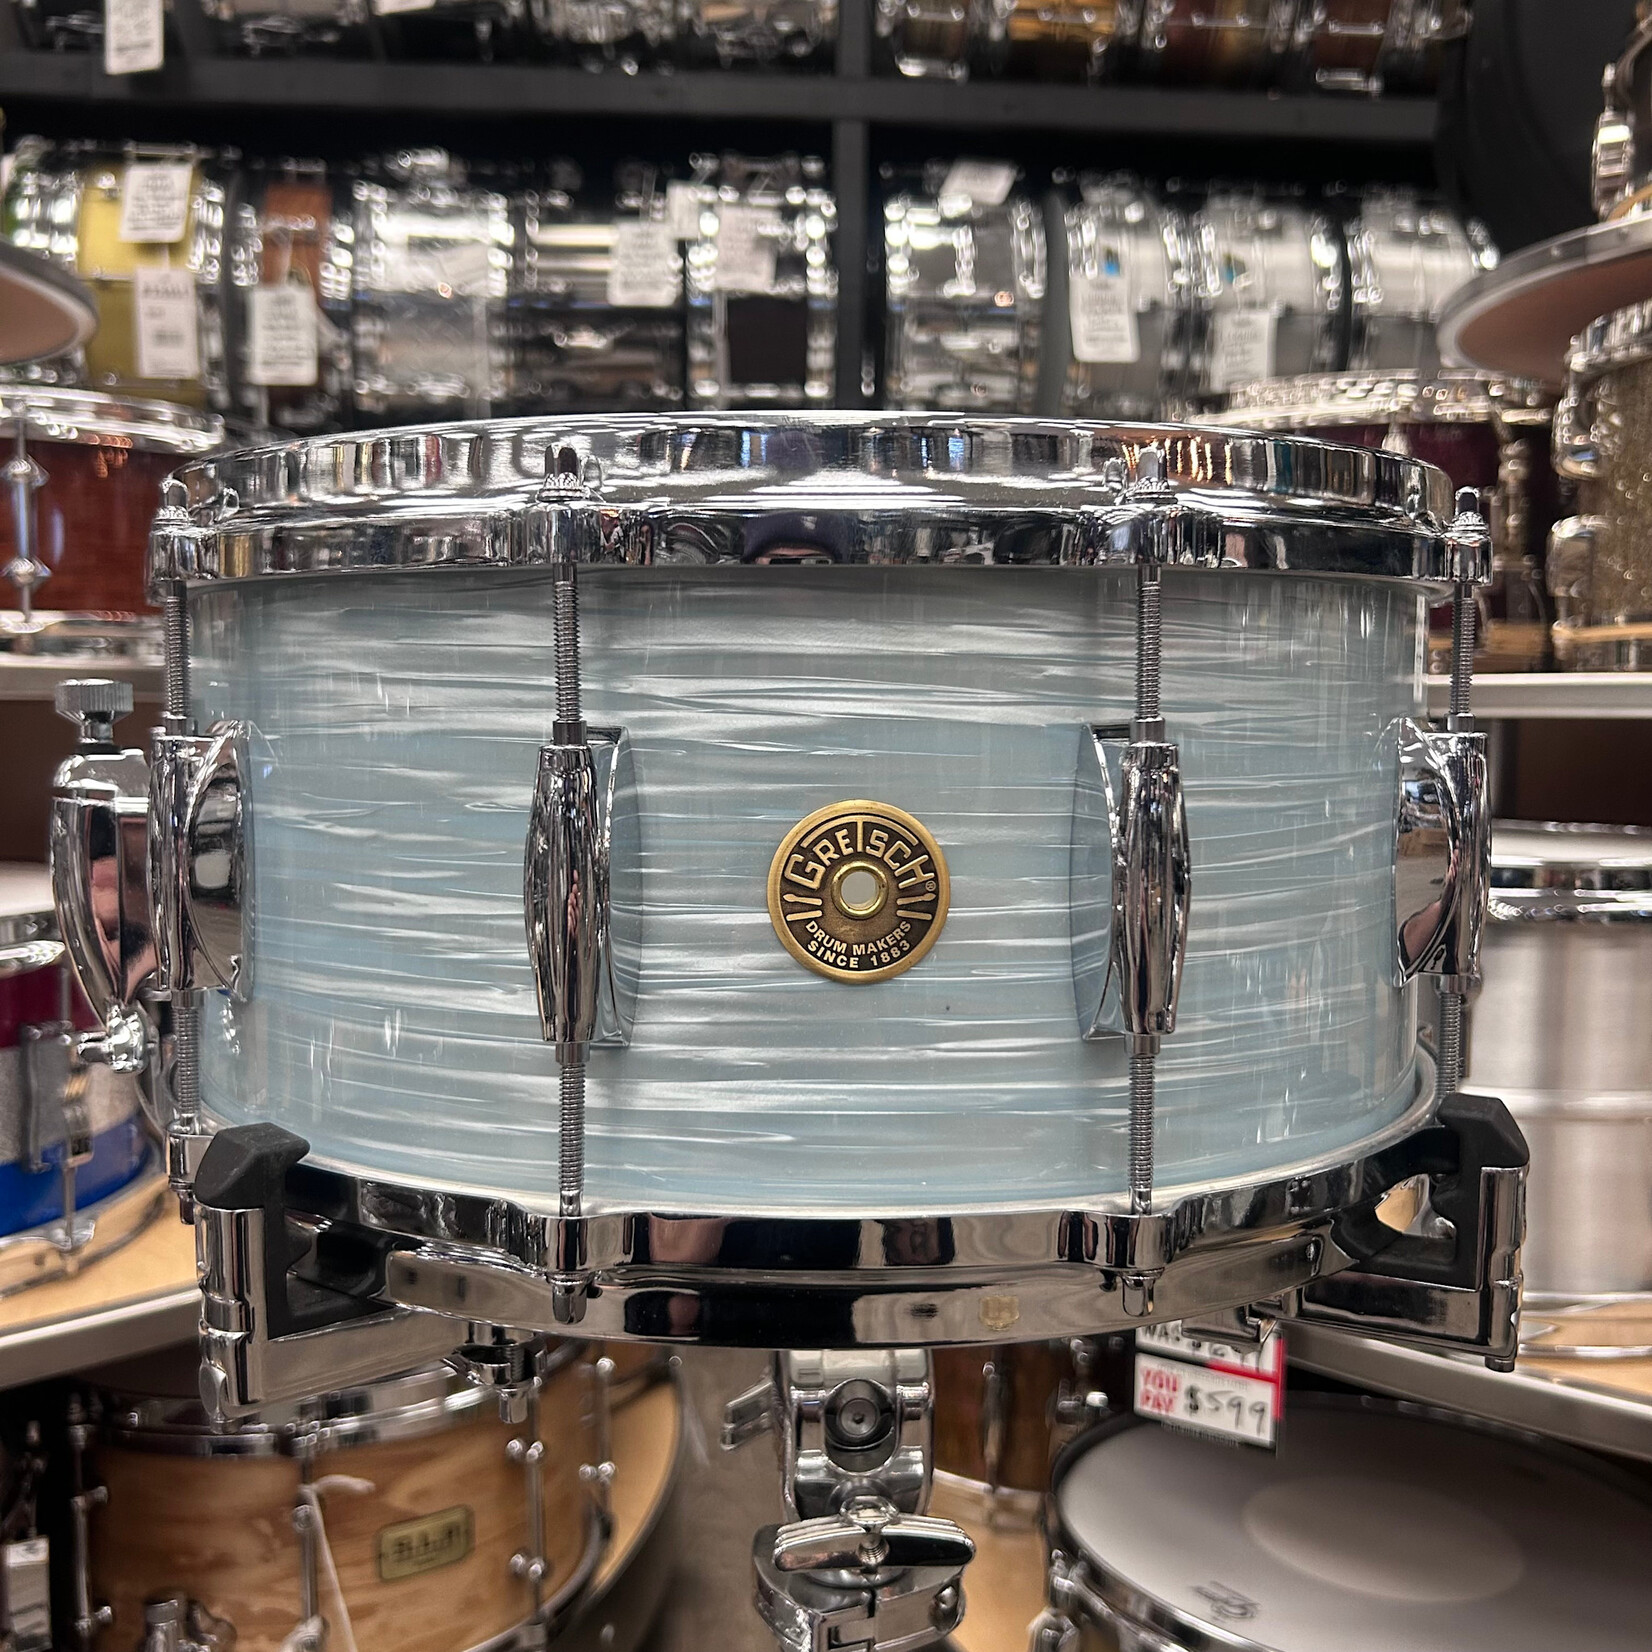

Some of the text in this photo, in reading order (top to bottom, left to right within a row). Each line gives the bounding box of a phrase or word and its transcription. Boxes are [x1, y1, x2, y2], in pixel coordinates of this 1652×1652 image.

[783, 814, 935, 890] GRETSCH
[805, 920, 911, 955] DRUM MAKERS
[807, 939, 911, 968] SINCE 1883
[1140, 1367, 1180, 1393] YOU
[1139, 1389, 1175, 1414] PAY
[1183, 1383, 1269, 1437] $599
